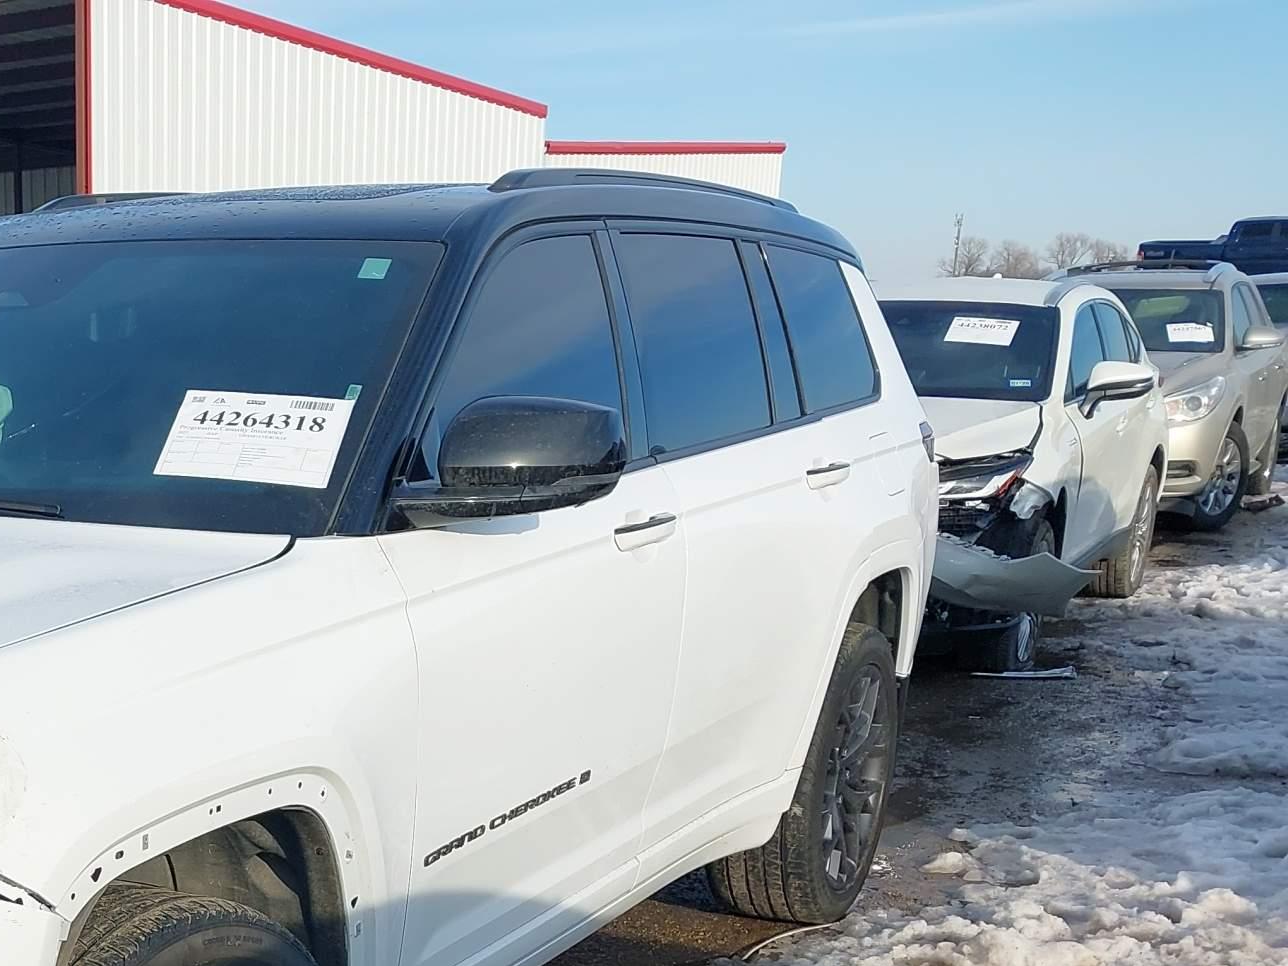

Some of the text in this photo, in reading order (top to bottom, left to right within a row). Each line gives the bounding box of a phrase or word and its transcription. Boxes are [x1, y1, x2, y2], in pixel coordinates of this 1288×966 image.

[193, 410, 326, 433] 44264318
[423, 777, 577, 868] GRAND CHEROKEE
